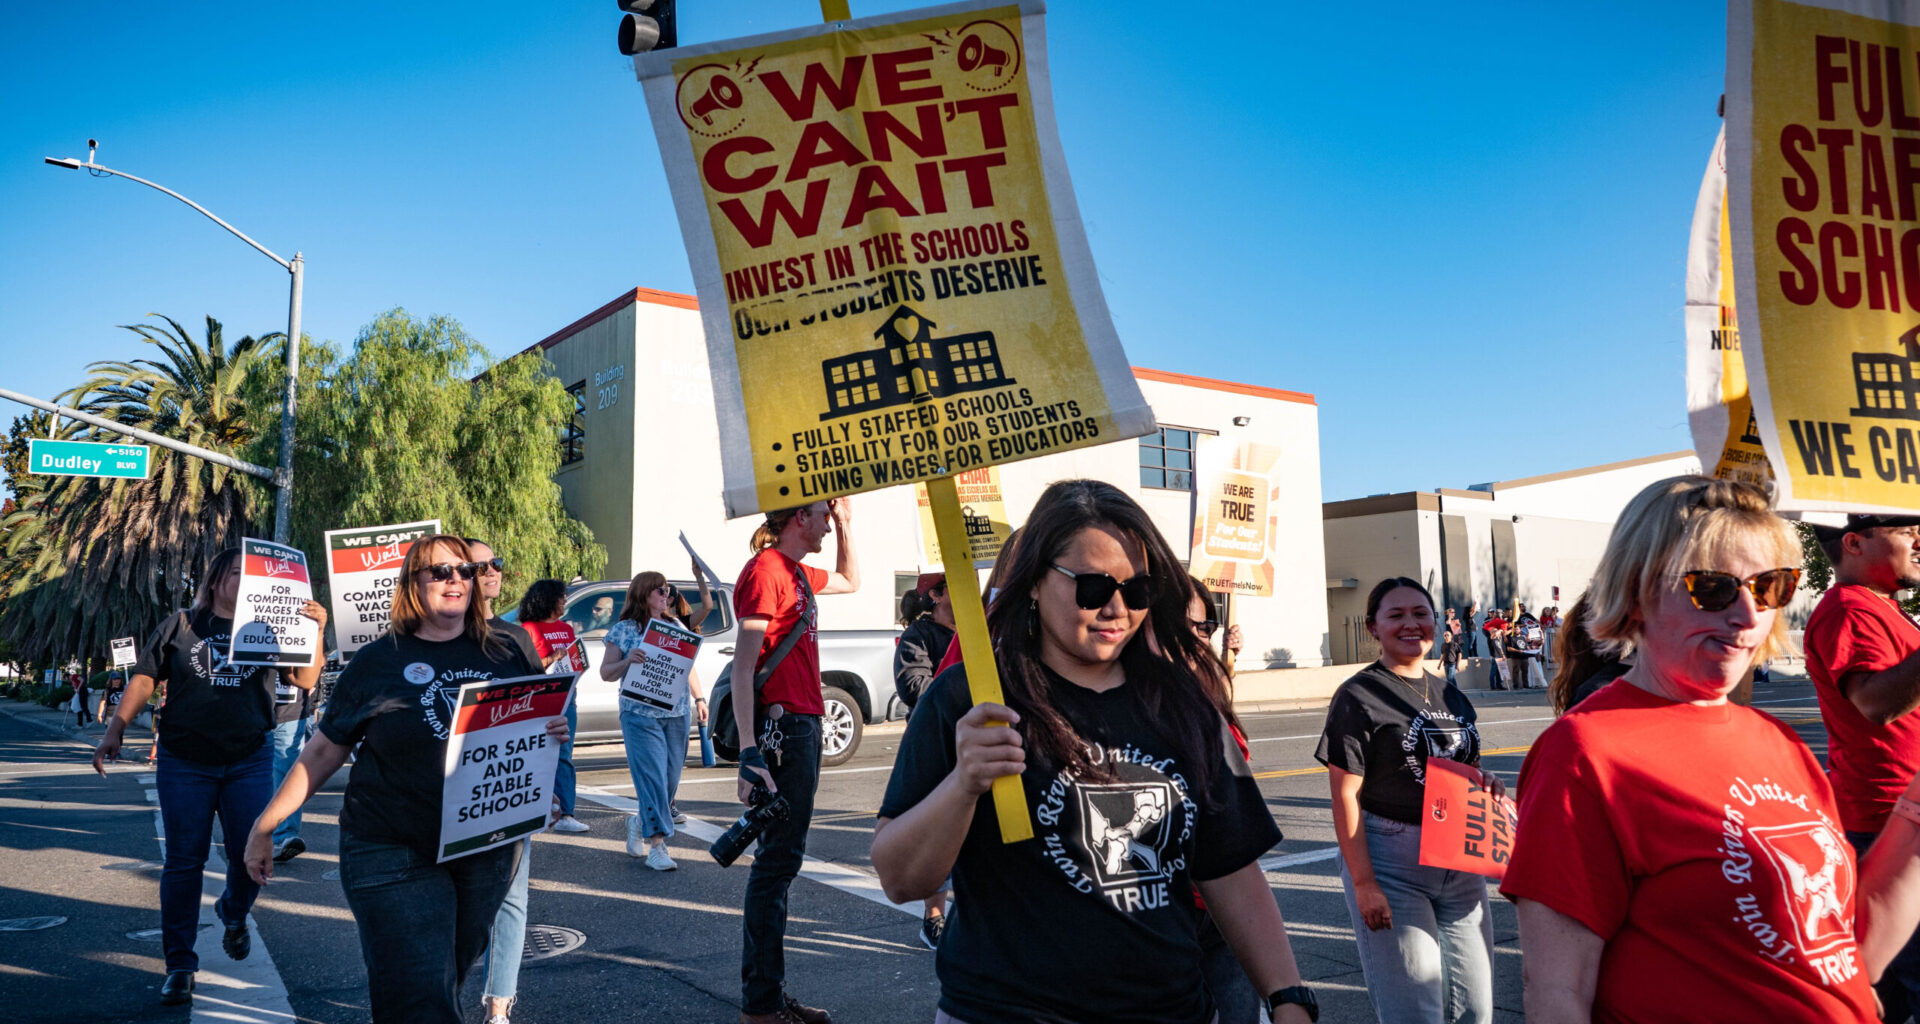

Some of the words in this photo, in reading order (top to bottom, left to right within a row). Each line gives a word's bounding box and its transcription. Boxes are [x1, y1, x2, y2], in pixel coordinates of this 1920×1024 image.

[758, 46, 944, 121] WE
[1816, 34, 1920, 131] FUL
[702, 93, 1019, 194] CAN'T
[717, 152, 1007, 248] WAIT
[725, 253, 816, 304] INVEST
[825, 246, 855, 280] IN
[860, 232, 907, 272] THE
[911, 220, 1030, 264] SCHOOLS
[932, 255, 1047, 300] DESERVE
[595, 365, 624, 386] Building
[598, 384, 618, 410] 209
[792, 422, 850, 452] FULLY
[860, 404, 939, 438] STAFFED
[944, 388, 1034, 421] SCHOOLS
[796, 440, 892, 473] STABILITY
[900, 429, 938, 454] FOR
[944, 422, 980, 445] OUR
[988, 400, 1082, 436] STUDENTS
[42, 454, 102, 472] Dudley
[116, 461, 136, 470] BLVD
[119, 448, 142, 456] 5150
[800, 466, 862, 498] LIVING
[870, 454, 940, 484] WAGES
[944, 443, 983, 472] FOR
[990, 417, 1099, 460] EDUCATORS
[1789, 420, 1862, 478] WE
[1869, 426, 1920, 484] CA
[1224, 483, 1238, 496] WE
[1238, 485, 1254, 498] ARE
[1221, 500, 1255, 522] TRUE
[343, 537, 371, 546] WE
[376, 530, 424, 544] CAN'T
[254, 546, 272, 554] WE
[274, 550, 299, 561] CAN'T
[272, 586, 290, 594] FOR
[254, 604, 292, 615] WAGES
[356, 600, 391, 612] WAG
[254, 615, 300, 625] BENEFITS
[266, 626, 286, 634] FOR
[656, 624, 668, 634] WE
[243, 635, 306, 646] EDUCATORS
[544, 632, 569, 640] PROTECT
[642, 664, 668, 676] WAGES
[646, 657, 684, 675] OMPETITIVE
[657, 654, 672, 663] FOR
[210, 677, 240, 686] TRUE
[631, 680, 672, 699] EDUCATORS
[641, 670, 672, 685] BENEFITS
[647, 680, 662, 688] FOR
[476, 686, 505, 701] WE
[510, 682, 562, 696] CAN'T
[424, 708, 449, 740] Twin
[441, 668, 492, 682] United
[1402, 716, 1424, 752] Rivers
[1420, 708, 1464, 724] United
[462, 744, 498, 766] FOR
[505, 733, 547, 756] SAFE
[483, 758, 525, 780] AND
[472, 772, 533, 801] STABLE
[1729, 777, 1810, 812] United
[458, 787, 541, 823] SCHOOLS
[1044, 834, 1092, 894] Twin
[1086, 742, 1175, 774] United
[1464, 778, 1486, 858] FULLY
[1492, 800, 1510, 865] STAF
[1717, 804, 1752, 884] Rivers
[1104, 883, 1170, 912] TRUE
[1733, 893, 1796, 964] Twin
[1809, 947, 1858, 986] TRUE
